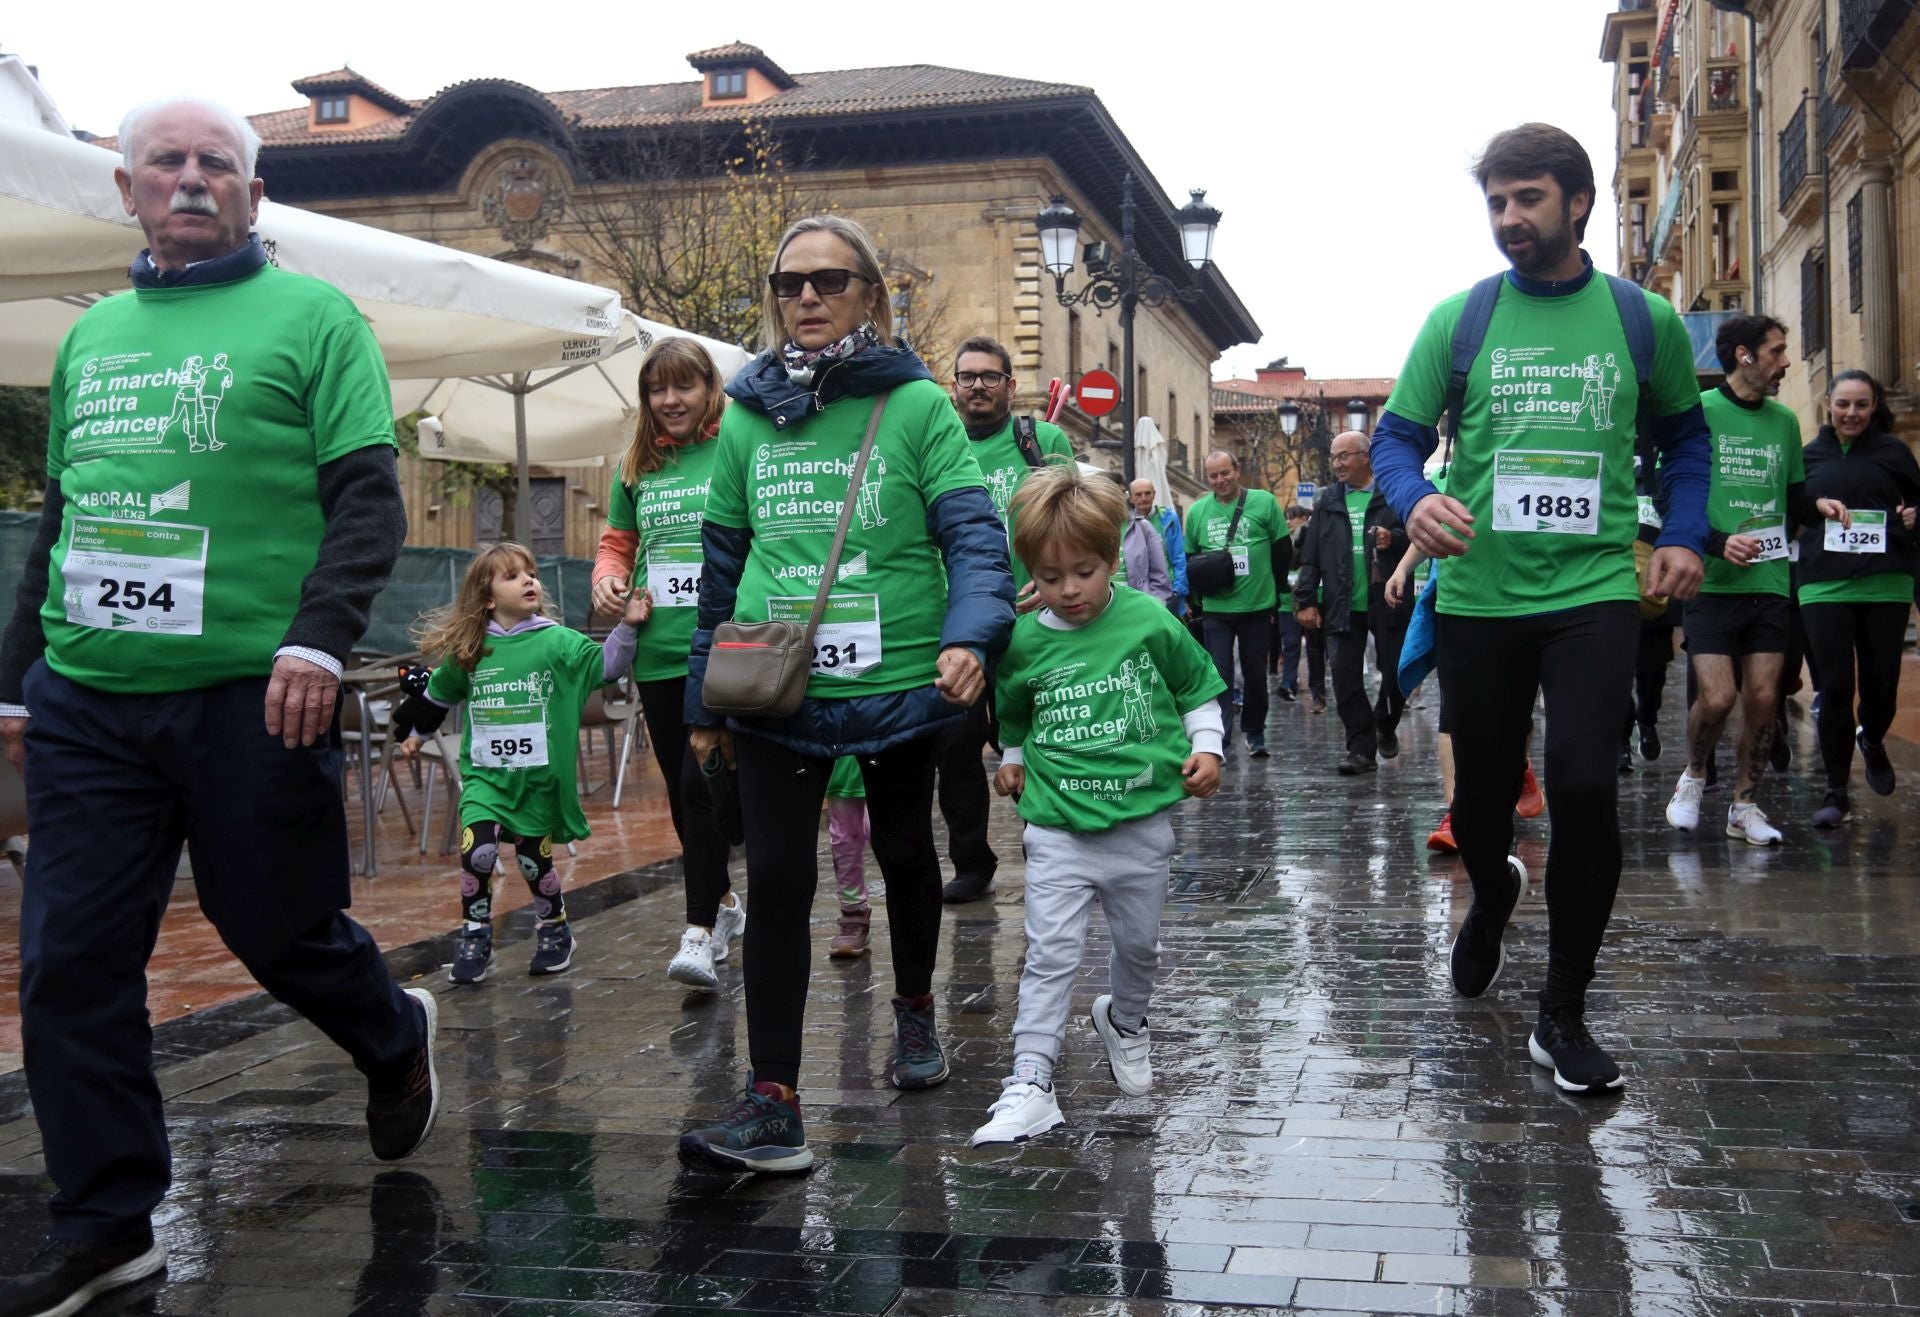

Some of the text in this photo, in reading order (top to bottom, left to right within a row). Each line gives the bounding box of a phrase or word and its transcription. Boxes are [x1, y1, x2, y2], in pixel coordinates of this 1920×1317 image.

[562, 338, 600, 350] CERVEZAS
[561, 348, 601, 361] ALHAMBRA
[1491, 363, 1594, 379] En marcha
[77, 367, 192, 398] En marcha
[1490, 380, 1552, 396] contra
[74, 394, 138, 419] contra
[1491, 396, 1580, 414] el cáncer
[71, 415, 169, 440] el cáncer
[1719, 444, 1733, 454] En
[1507, 463, 1531, 471] cáncer
[1719, 456, 1752, 466] contra
[756, 462, 778, 480] En
[1720, 465, 1730, 474] el
[642, 491, 655, 503] En
[756, 479, 814, 499] contra
[73, 491, 146, 508] ABORAL
[1517, 494, 1590, 519] 1883
[111, 508, 146, 520] kutxa
[640, 501, 681, 516] contra
[757, 498, 845, 519] el cáncer
[642, 516, 651, 530] el
[654, 511, 704, 527] cáncer
[76, 524, 98, 534] Oviedo
[146, 530, 180, 541] contra
[1839, 532, 1880, 545] 1326
[771, 564, 826, 579] LABORA
[97, 578, 176, 613] 254
[833, 601, 859, 609] contra
[483, 679, 536, 695] marcha
[1054, 674, 1131, 702] marcha
[1038, 704, 1091, 724] contra
[1035, 717, 1125, 744] el cáncer
[491, 738, 533, 756] 595
[1059, 778, 1123, 792] ABORAL
[1093, 791, 1123, 801] kutxa
